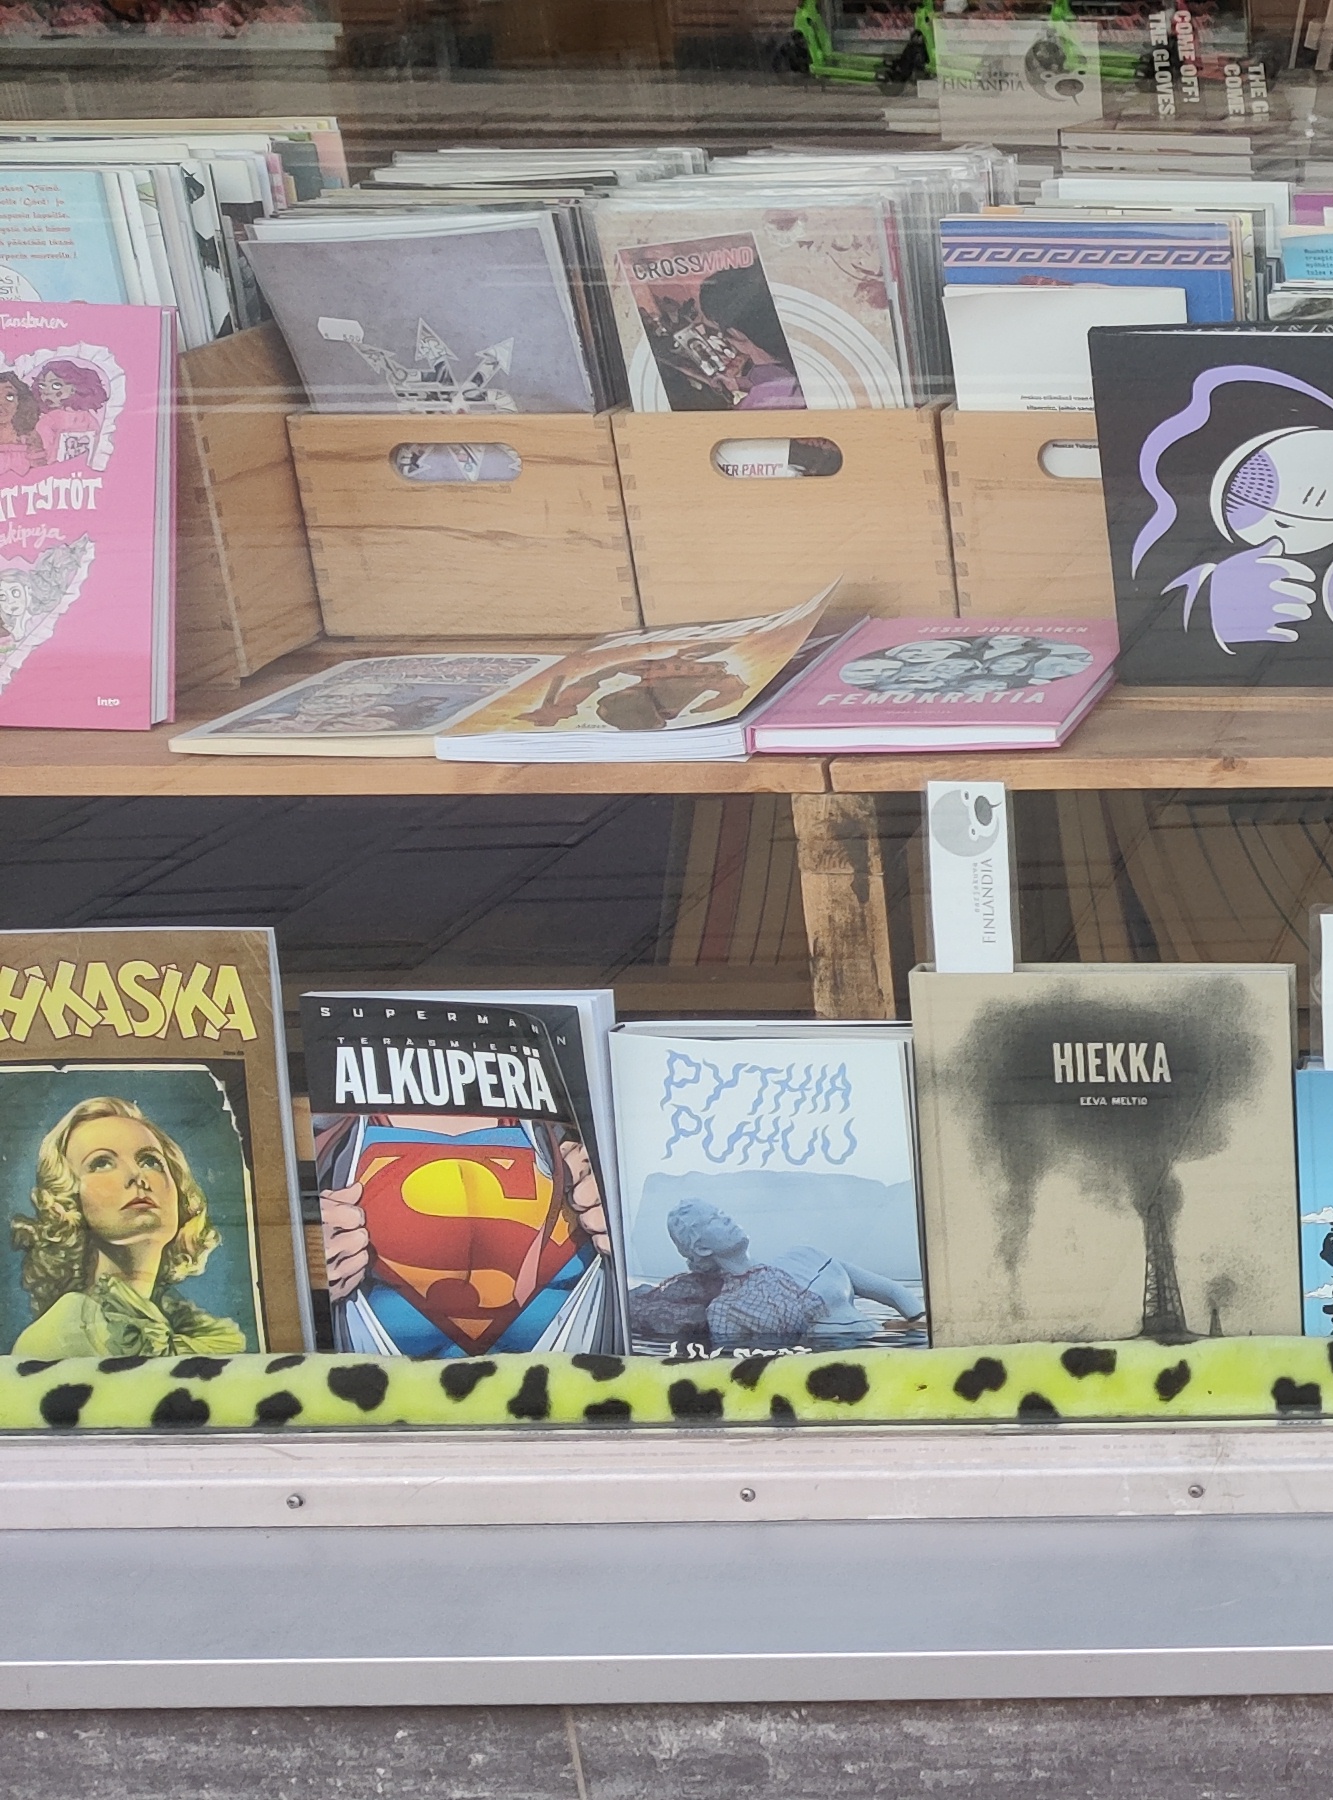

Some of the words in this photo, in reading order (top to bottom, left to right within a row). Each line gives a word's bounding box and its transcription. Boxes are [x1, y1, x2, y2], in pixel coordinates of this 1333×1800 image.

[1149, 14, 1168, 46] THE
[1174, 10, 1194, 61] COME
[1179, 64, 1200, 104] OFF!
[1224, 64, 1245, 115] COME
[1247, 63, 1266, 99] THE
[632, 246, 753, 281] CROSSWIND
[24, 471, 102, 511] TYTÖT
[918, 626, 969, 634] JESSI
[97, 696, 120, 707] into
[818, 691, 1045, 706] FEMOKRATIA
[981, 858, 996, 944] FINLANDIA
[0, 959, 258, 1043] HKASIKA
[335, 1045, 557, 1113] ALKUPERÄ
[1053, 1042, 1171, 1083] HIEKKA
[660, 1049, 852, 1117] PYTHIA
[1080, 1097, 1107, 1106] EEVA
[1111, 1097, 1148, 1106] MELTIO
[661, 1103, 857, 1168] PUHUU
